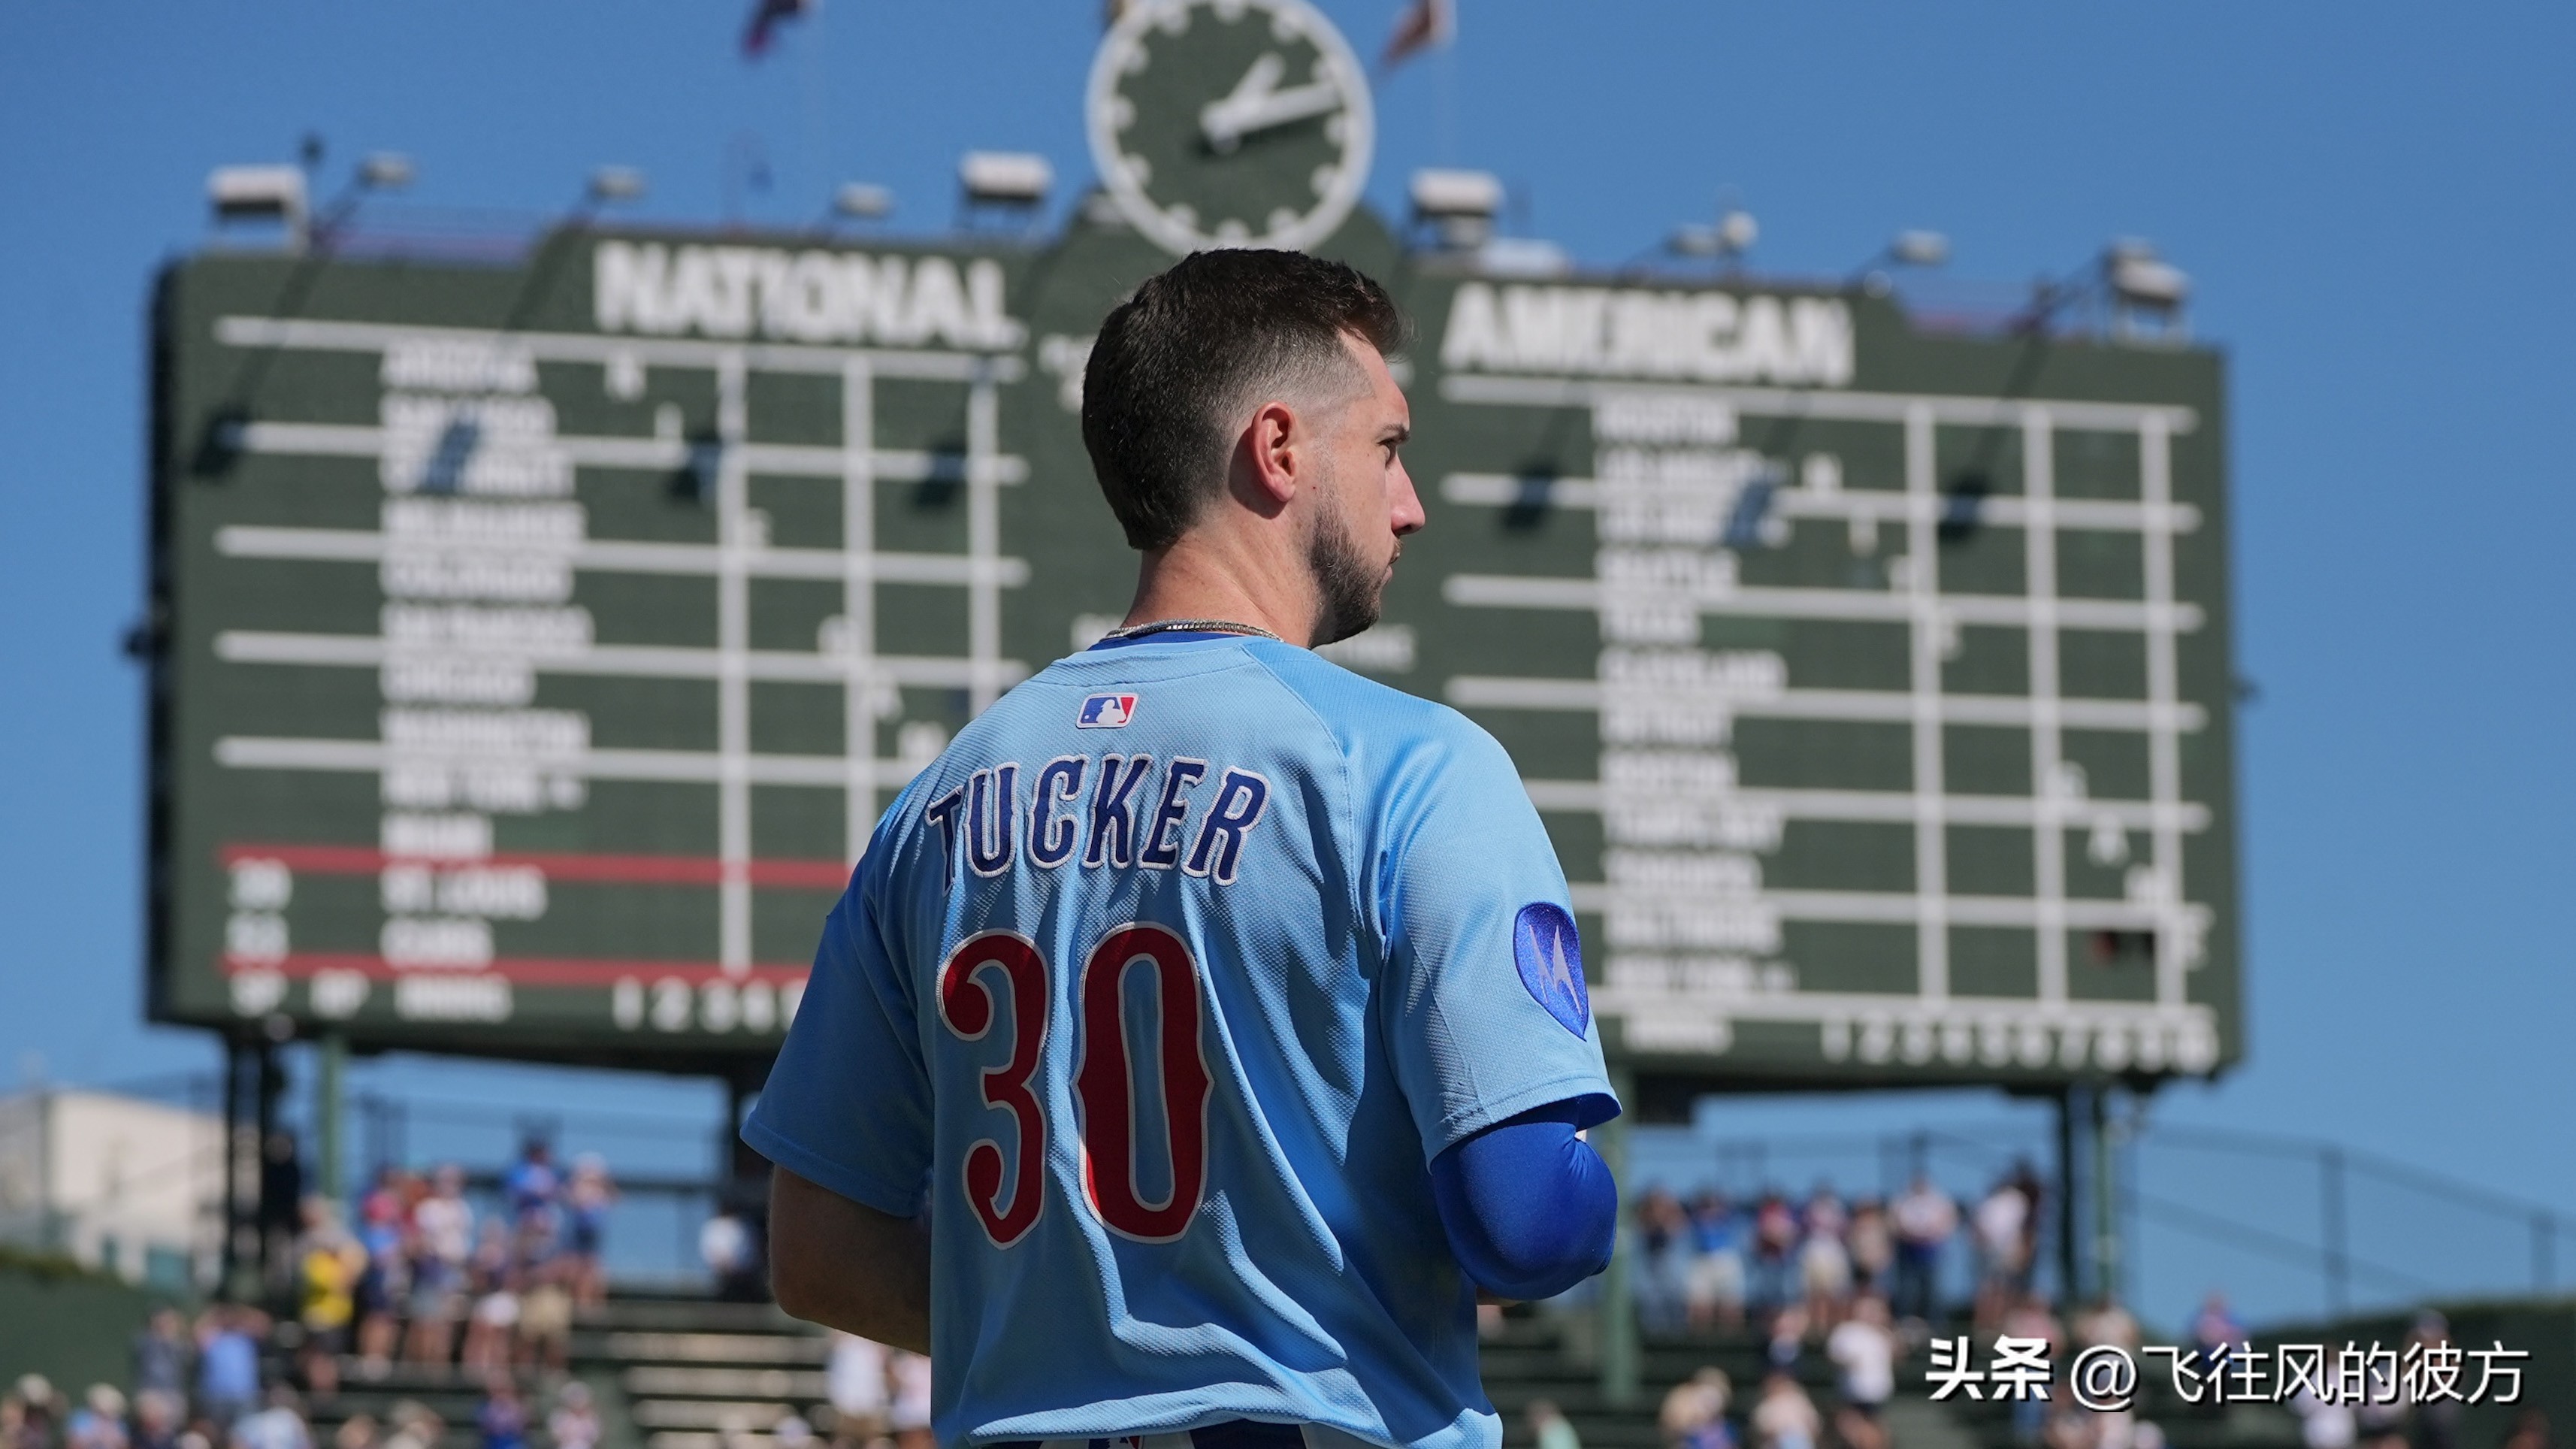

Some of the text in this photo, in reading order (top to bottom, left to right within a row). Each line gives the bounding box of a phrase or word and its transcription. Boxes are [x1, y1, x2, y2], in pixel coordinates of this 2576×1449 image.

[594, 240, 1020, 352] NATIONAL
[1444, 283, 1855, 383] AMERICAN
[925, 752, 1272, 894] TUCKER
[936, 921, 1214, 1249] 30
